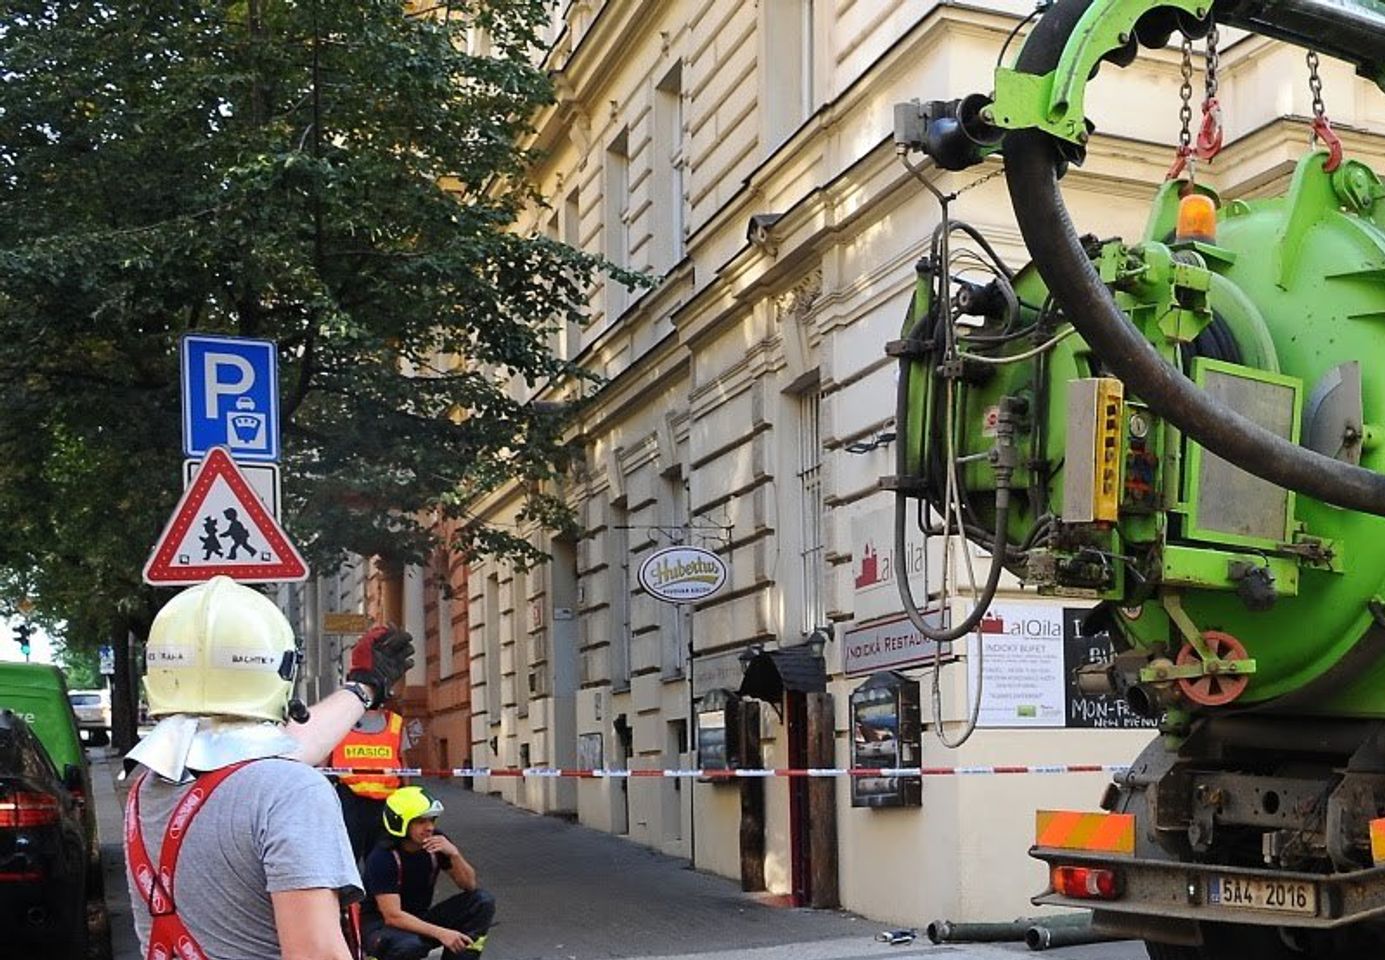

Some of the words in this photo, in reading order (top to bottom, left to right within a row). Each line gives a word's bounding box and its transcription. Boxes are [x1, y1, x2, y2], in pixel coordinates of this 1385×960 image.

[204, 352, 256, 419] P
[1124, 717, 1158, 727] MENU
[1224, 881, 1253, 903] 5A4
[1266, 884, 1307, 908] 2016
